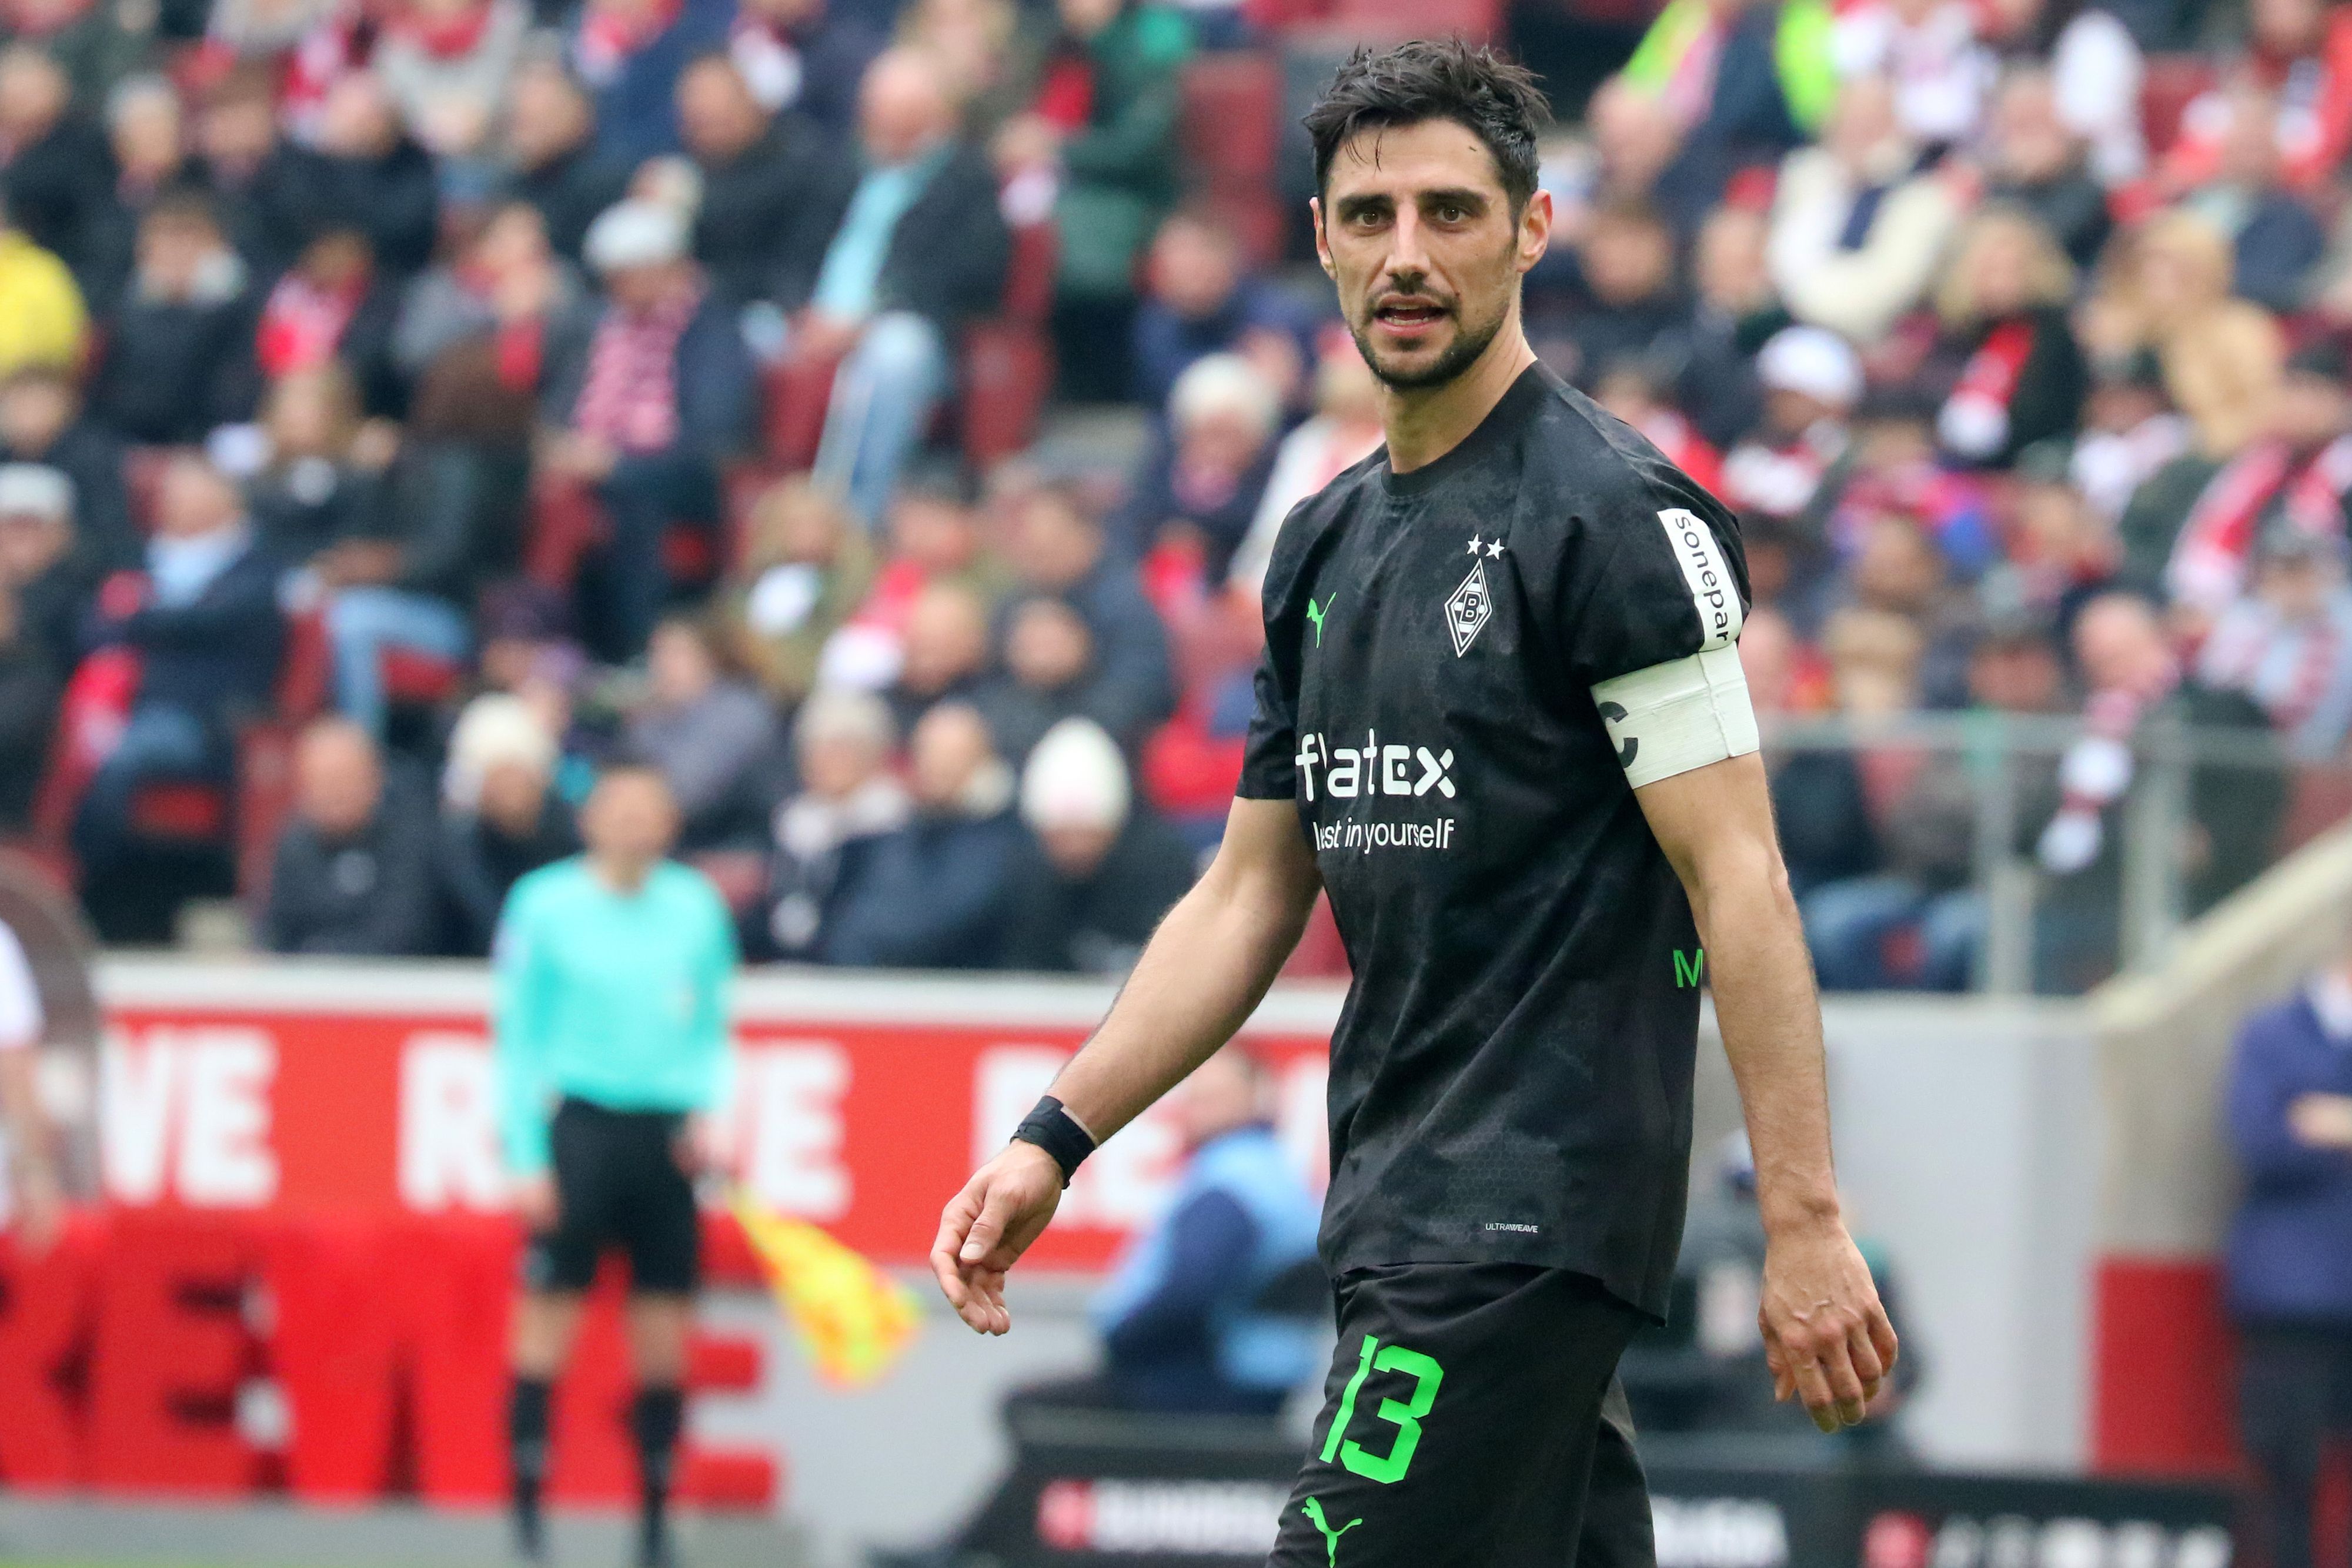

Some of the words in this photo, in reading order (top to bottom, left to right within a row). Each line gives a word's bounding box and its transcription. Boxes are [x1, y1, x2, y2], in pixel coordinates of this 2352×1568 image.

[1675, 516, 1729, 641] sonepar
[1459, 591, 1482, 624] B
[1345, 817, 1362, 848] in
[1364, 817, 1455, 854] yourself
[1485, 1222, 1539, 1233] ULTRAWEAVE
[1318, 1334, 1445, 1485] 13
